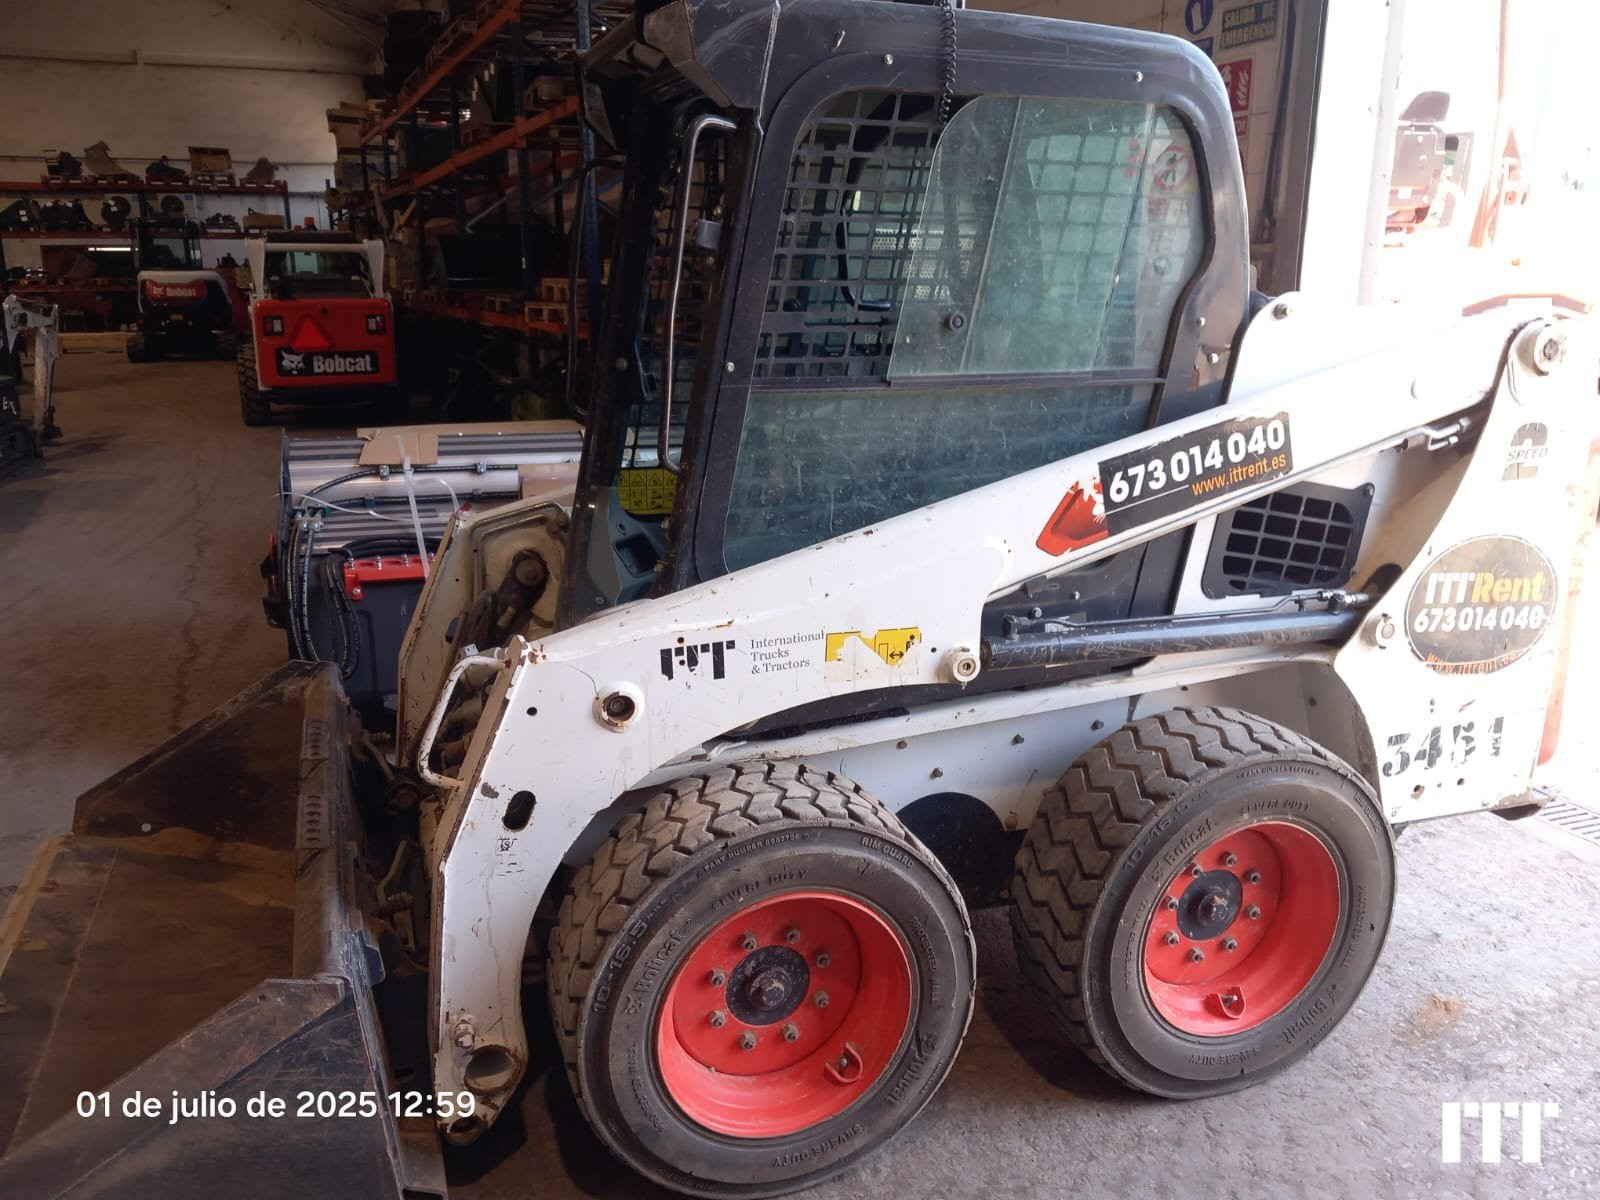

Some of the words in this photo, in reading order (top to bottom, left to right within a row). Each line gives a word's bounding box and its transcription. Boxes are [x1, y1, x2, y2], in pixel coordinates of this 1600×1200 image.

[1223, 7, 1255, 28] SALIDA
[1262, 2, 1276, 19] DE
[1220, 20, 1276, 48] EMERGENCIA
[165, 287, 197, 297] Bobcat
[312, 353, 373, 374] Bobcat
[1505, 447, 1548, 462] SPEED
[1191, 453, 1287, 497] www.ittrent.es
[750, 630, 825, 649] International
[750, 648, 790, 662] Trucks
[751, 664, 761, 675] &
[762, 657, 811, 673] Tractors
[860, 836, 881, 851] RIM
[882, 844, 915, 869] GUARD
